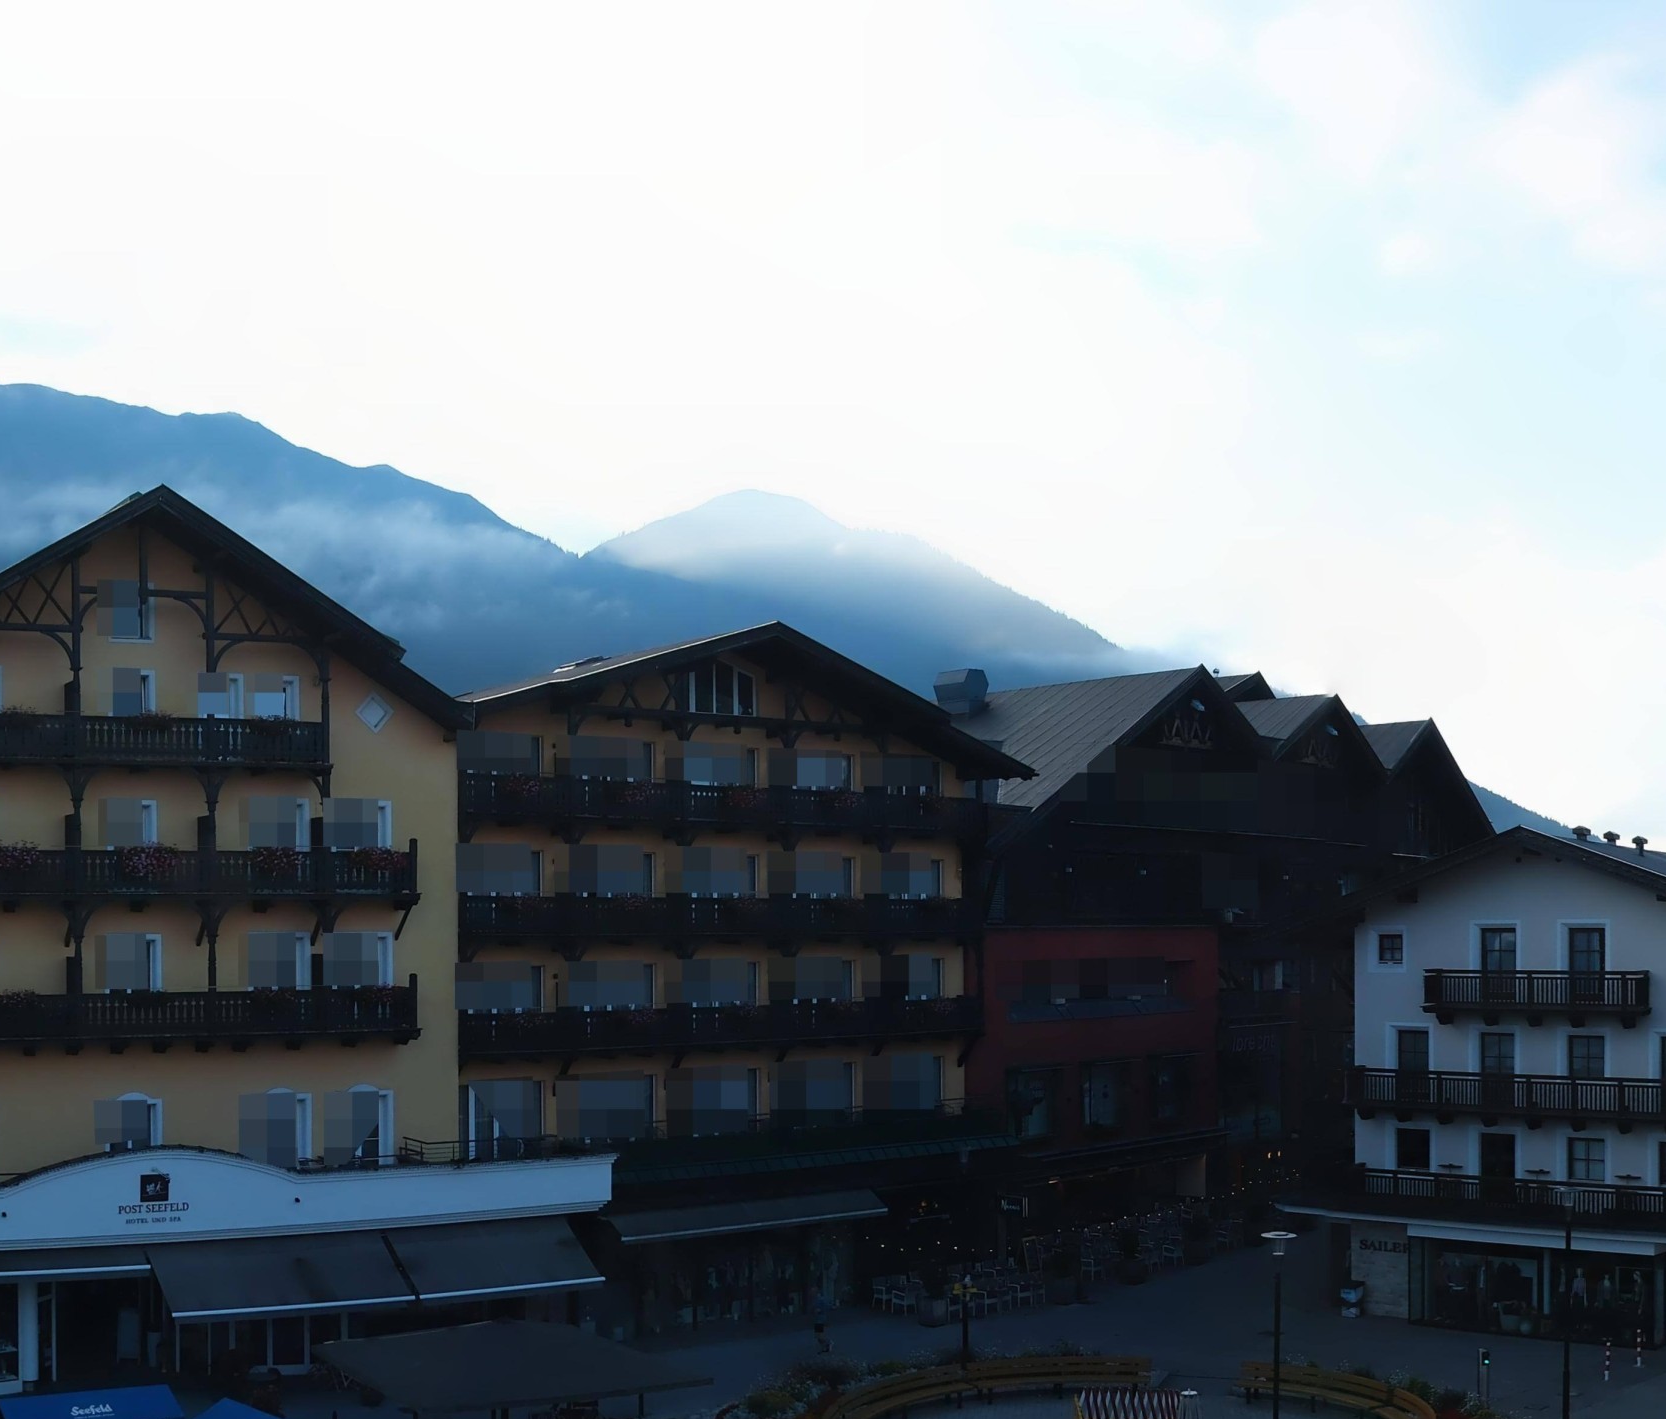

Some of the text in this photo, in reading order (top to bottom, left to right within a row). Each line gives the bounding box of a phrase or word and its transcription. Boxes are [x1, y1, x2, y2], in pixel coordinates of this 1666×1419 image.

[118, 1202, 189, 1214] POST SEEFELD
[71, 1404, 112, 1416] Seefeld
